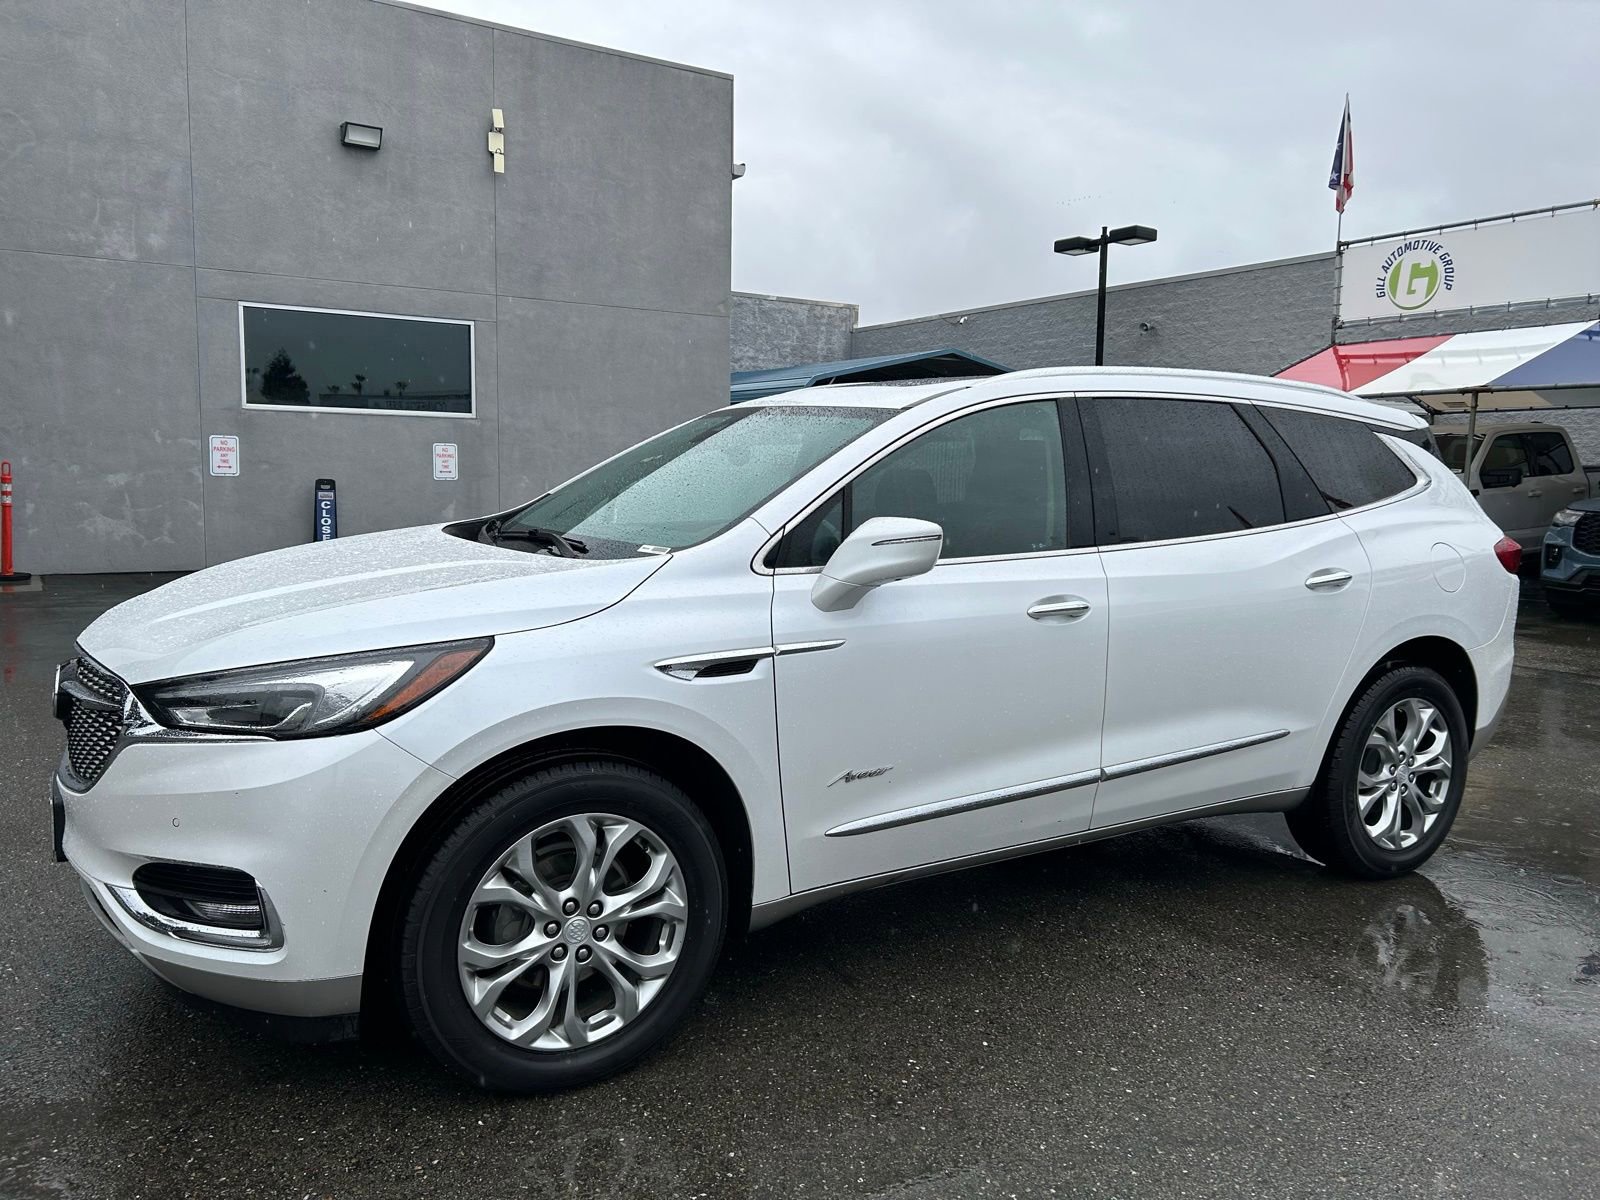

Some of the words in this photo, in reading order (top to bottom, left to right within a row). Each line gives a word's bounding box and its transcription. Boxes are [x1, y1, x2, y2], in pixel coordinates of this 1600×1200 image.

[1375, 276, 1386, 298] GILL
[1381, 239, 1444, 274] AUTOMOTIVE
[1439, 252, 1455, 291] GROUP
